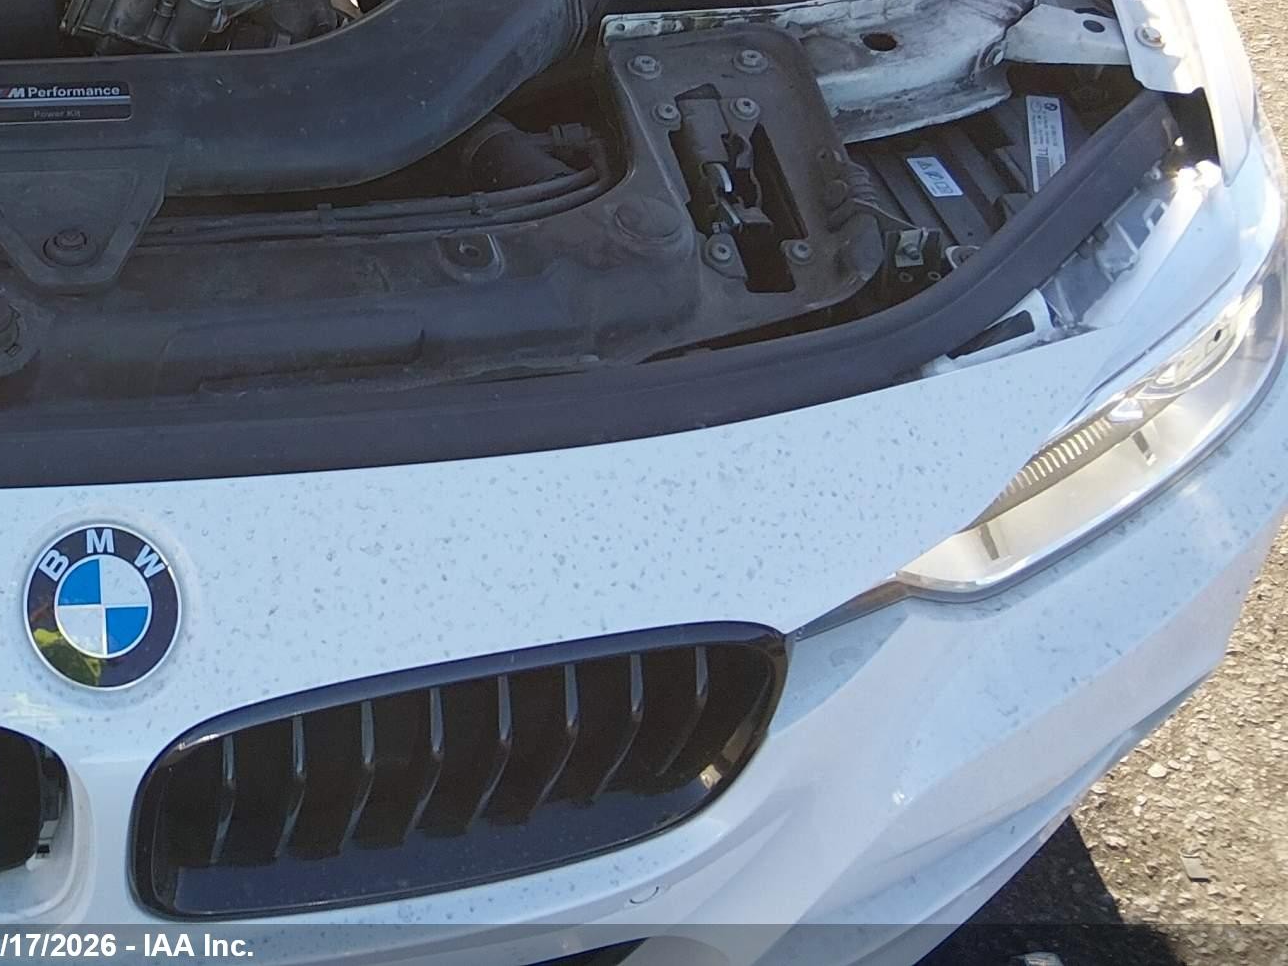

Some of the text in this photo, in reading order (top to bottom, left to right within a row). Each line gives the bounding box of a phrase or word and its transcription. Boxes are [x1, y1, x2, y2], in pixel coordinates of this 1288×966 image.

[27, 86, 120, 98] Performance
[33, 110, 65, 118] Power
[39, 528, 166, 582] BMW
